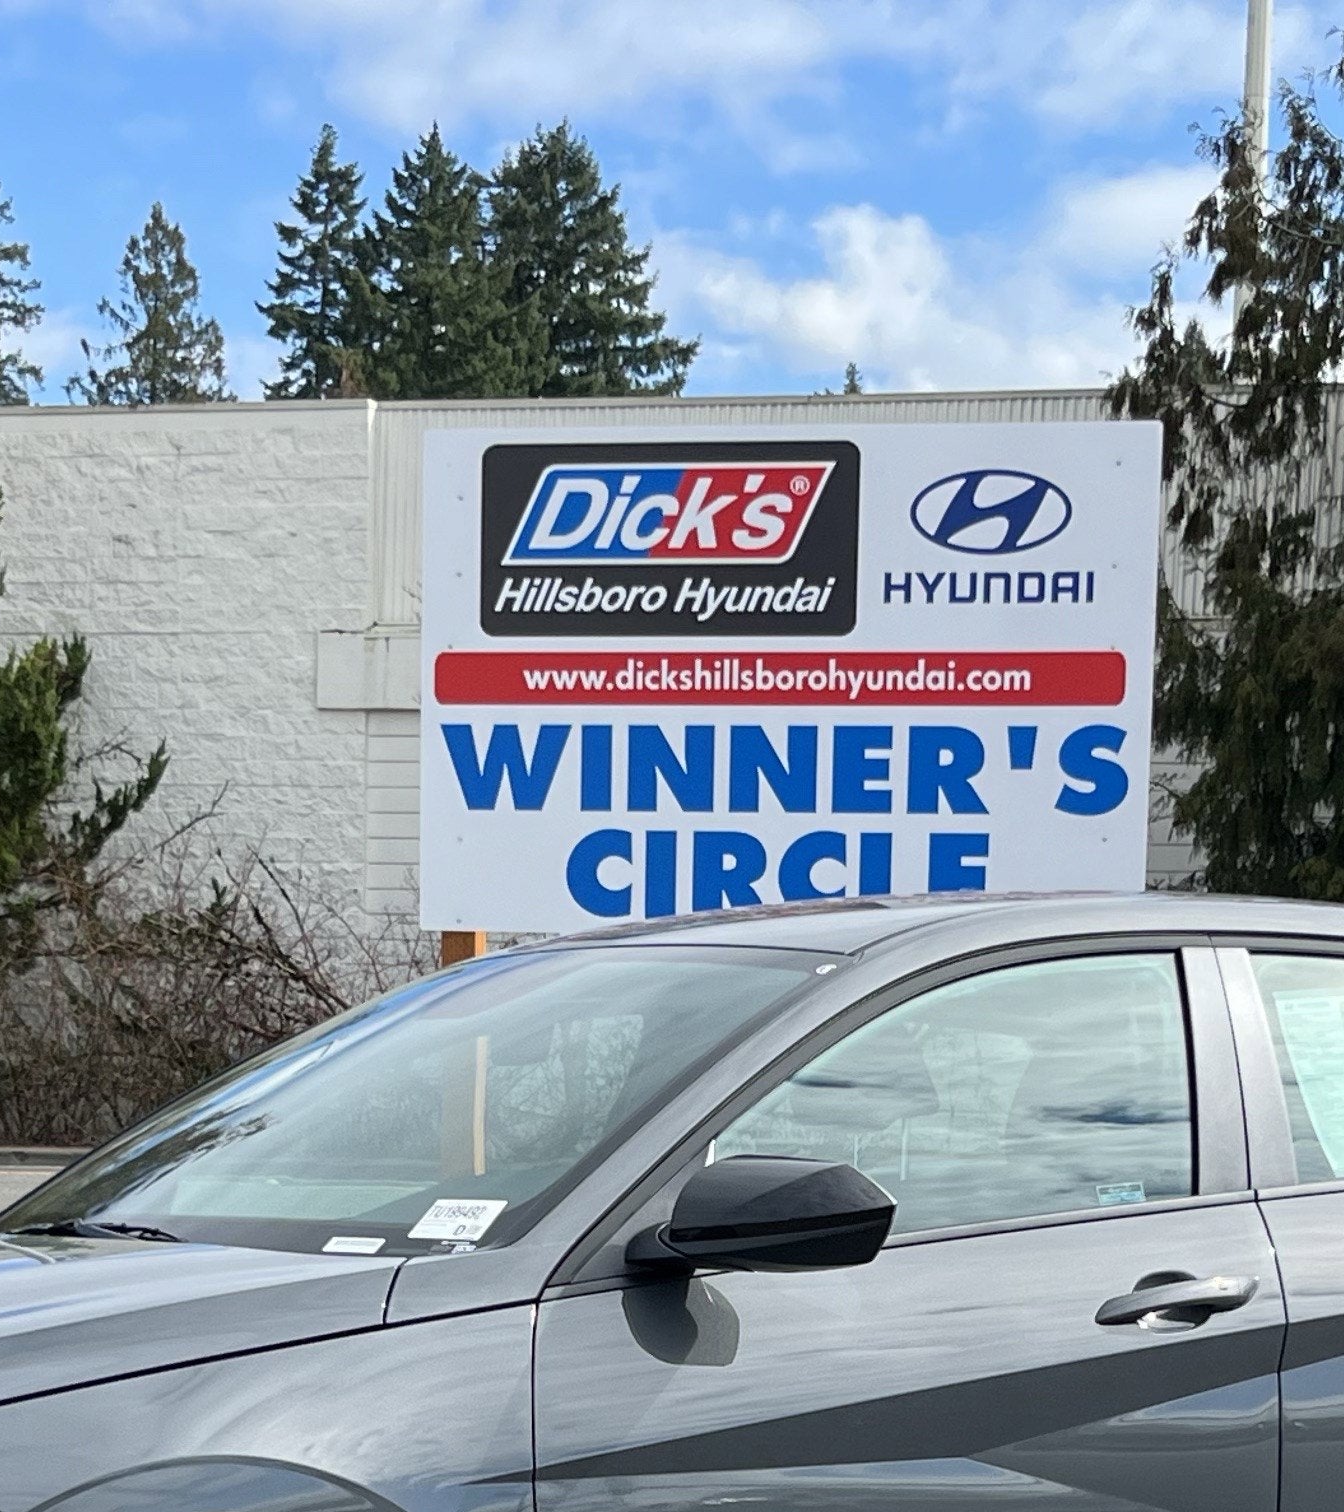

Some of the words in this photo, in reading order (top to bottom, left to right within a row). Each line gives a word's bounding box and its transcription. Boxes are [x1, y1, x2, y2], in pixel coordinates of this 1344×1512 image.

[494, 577, 668, 613] Hillsboro
[673, 576, 836, 622] Hyundai
[883, 571, 1095, 604] HYUNDAI
[523, 658, 1032, 700] www.dickshillsborohyundai.com
[440, 723, 1129, 816] WINNER'S
